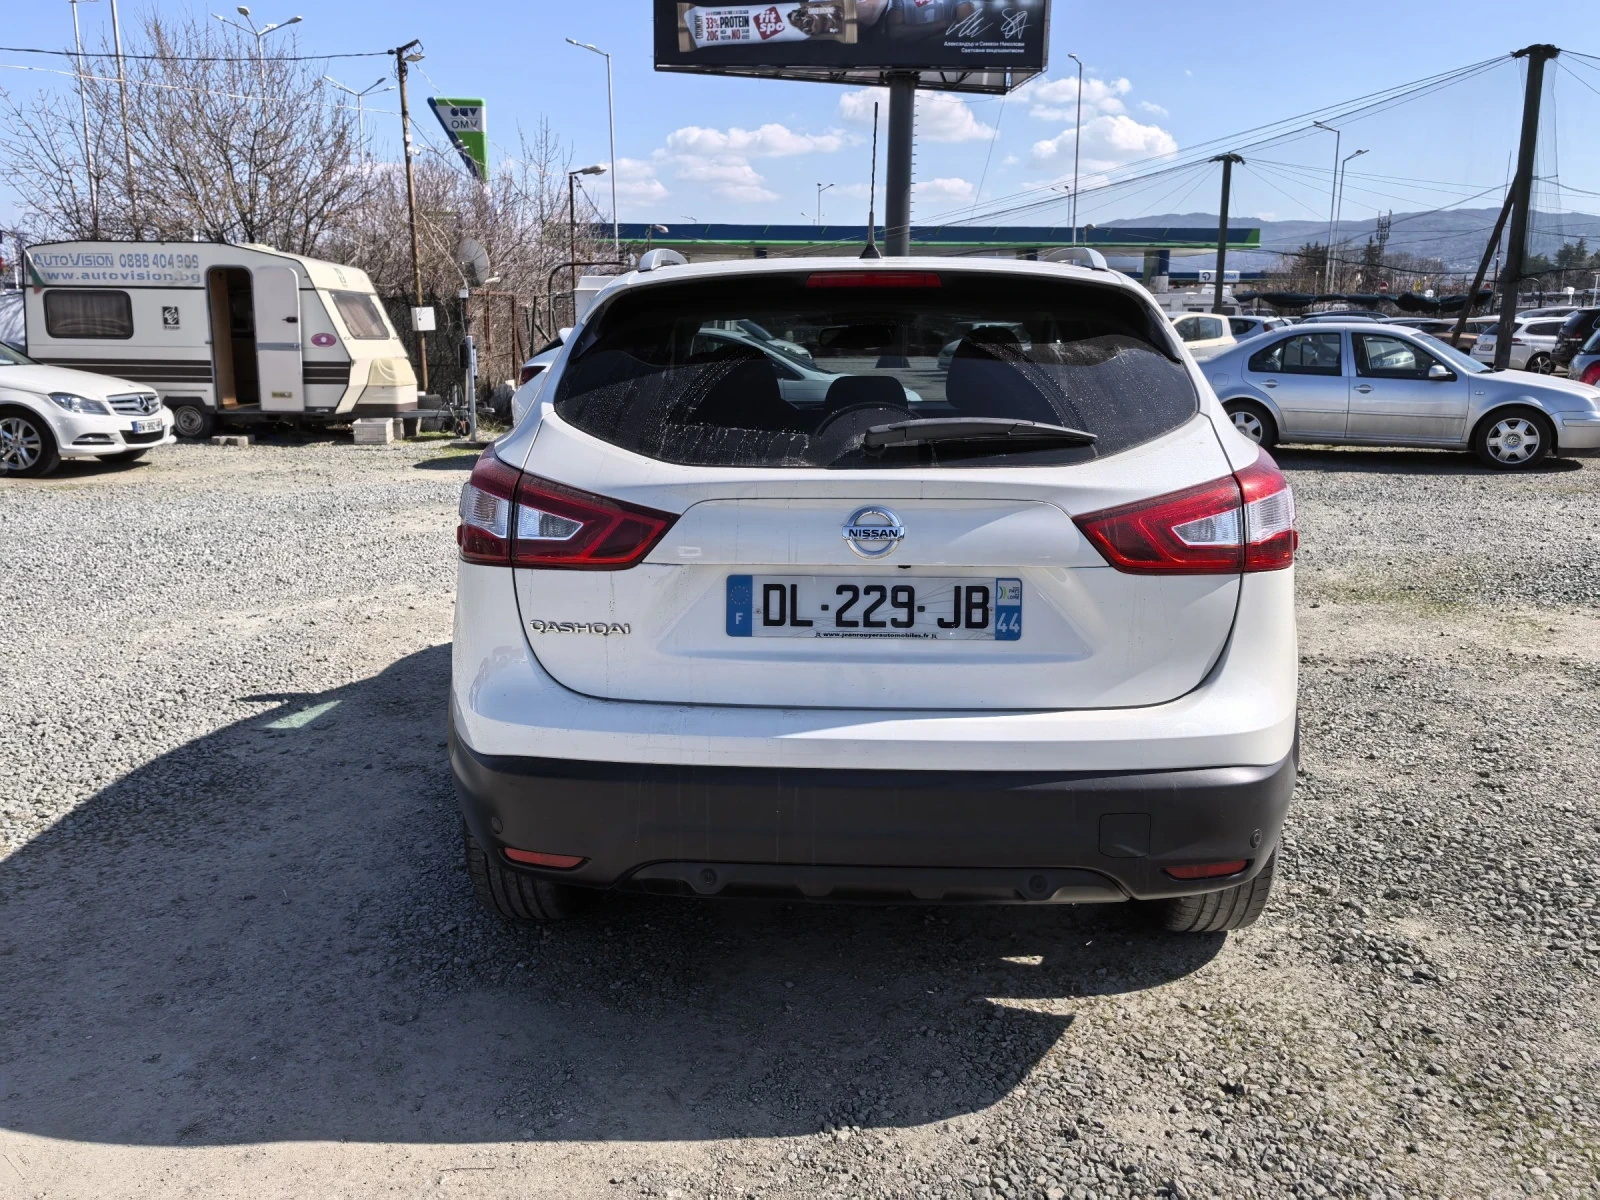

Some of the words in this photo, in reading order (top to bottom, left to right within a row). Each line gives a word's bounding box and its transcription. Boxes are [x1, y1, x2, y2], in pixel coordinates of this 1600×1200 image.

[706, 17, 720, 30] 33%
[720, 16, 750, 28] PROTEIN
[759, 11, 777, 23] fit
[731, 29, 741, 40] NO
[760, 22, 784, 35] spo
[707, 30, 719, 41] 20G
[451, 120, 478, 129] OMV
[119, 253, 150, 268] 0888
[152, 253, 175, 268] 404
[41, 270, 201, 283] ww.autovision.bg
[848, 529, 898, 538] NISSAN
[735, 612, 744, 624] F
[996, 612, 1020, 633] 44
[530, 619, 631, 636] QASHQAI
